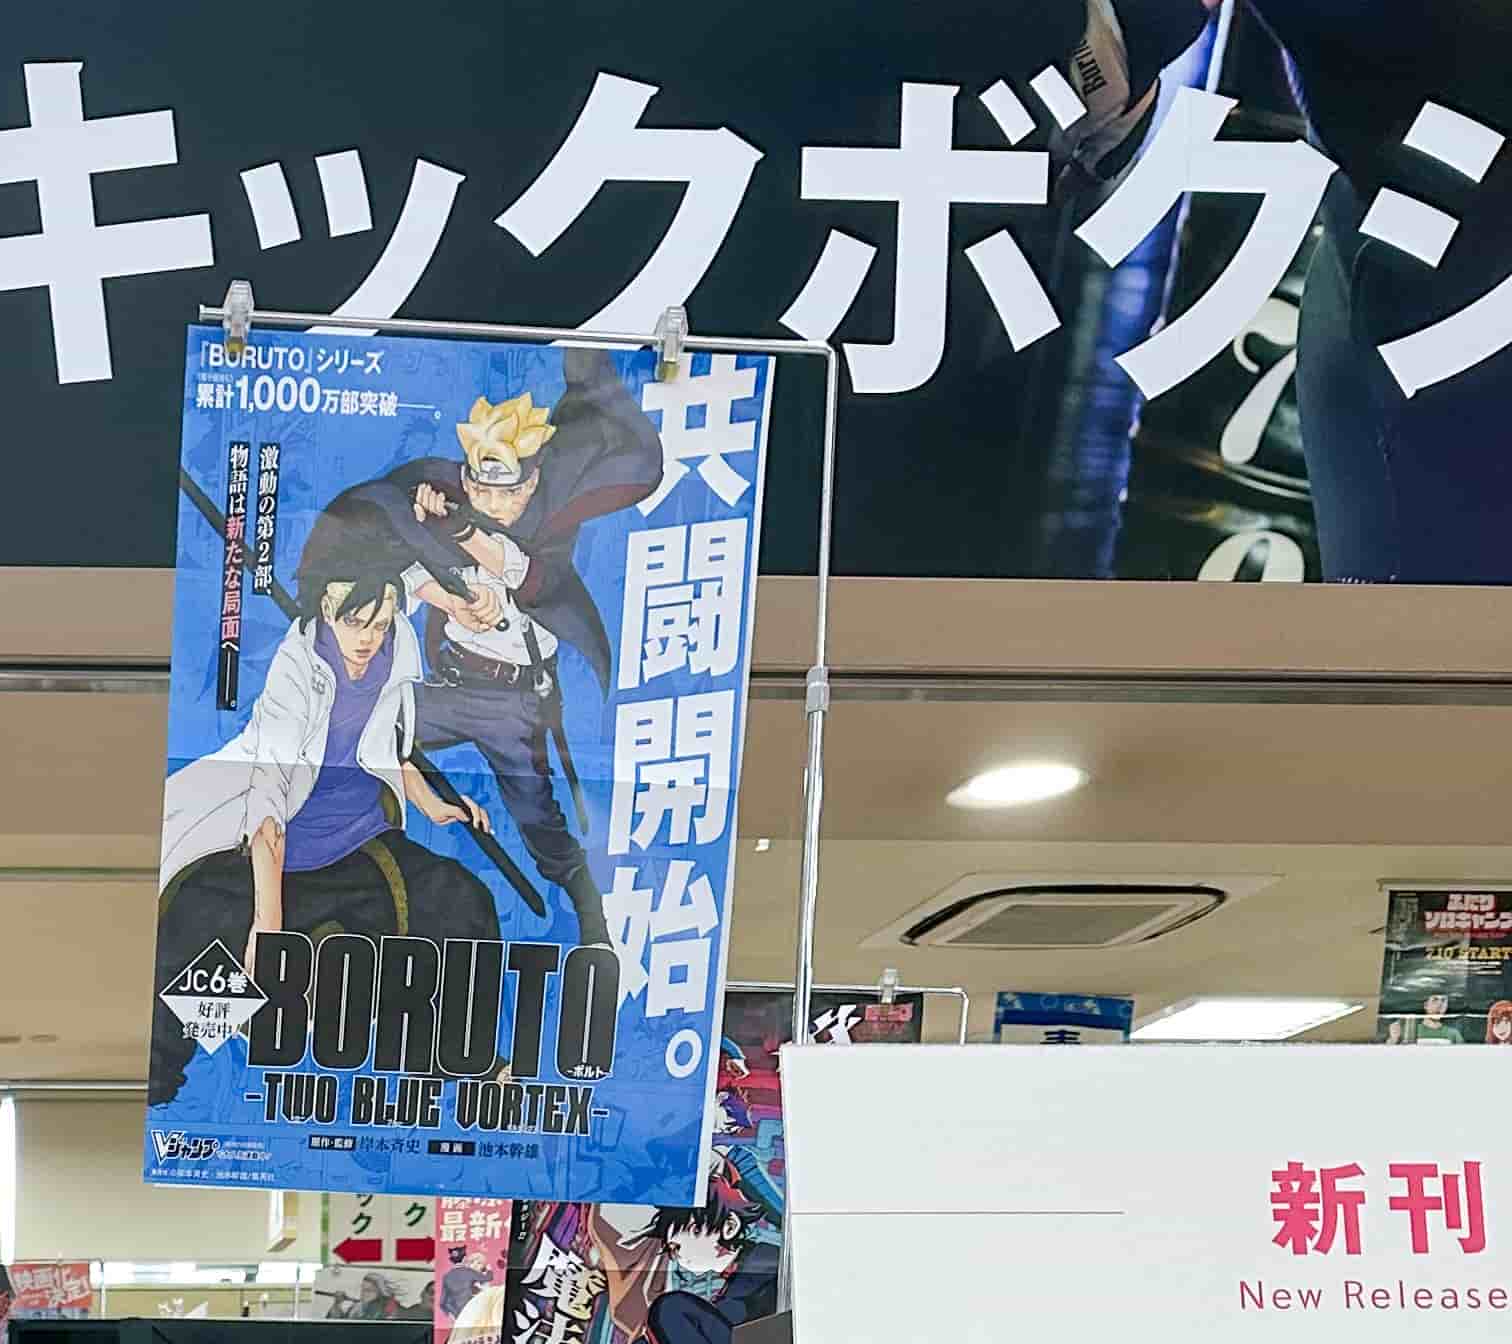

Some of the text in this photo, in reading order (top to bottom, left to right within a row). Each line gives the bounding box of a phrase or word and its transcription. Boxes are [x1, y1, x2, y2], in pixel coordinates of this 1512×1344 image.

[601, 350, 758, 1078] 共闘開始。
[178, 962, 249, 995] JC6巻
[196, 1000, 232, 1020] 好評
[246, 930, 619, 1081] BORUTO
[351, 1076, 442, 1129] BLUE
[438, 1214, 510, 1242] 最新
[1270, 1159, 1488, 1258] 新刊
[1239, 1279, 1510, 1313] New Release
